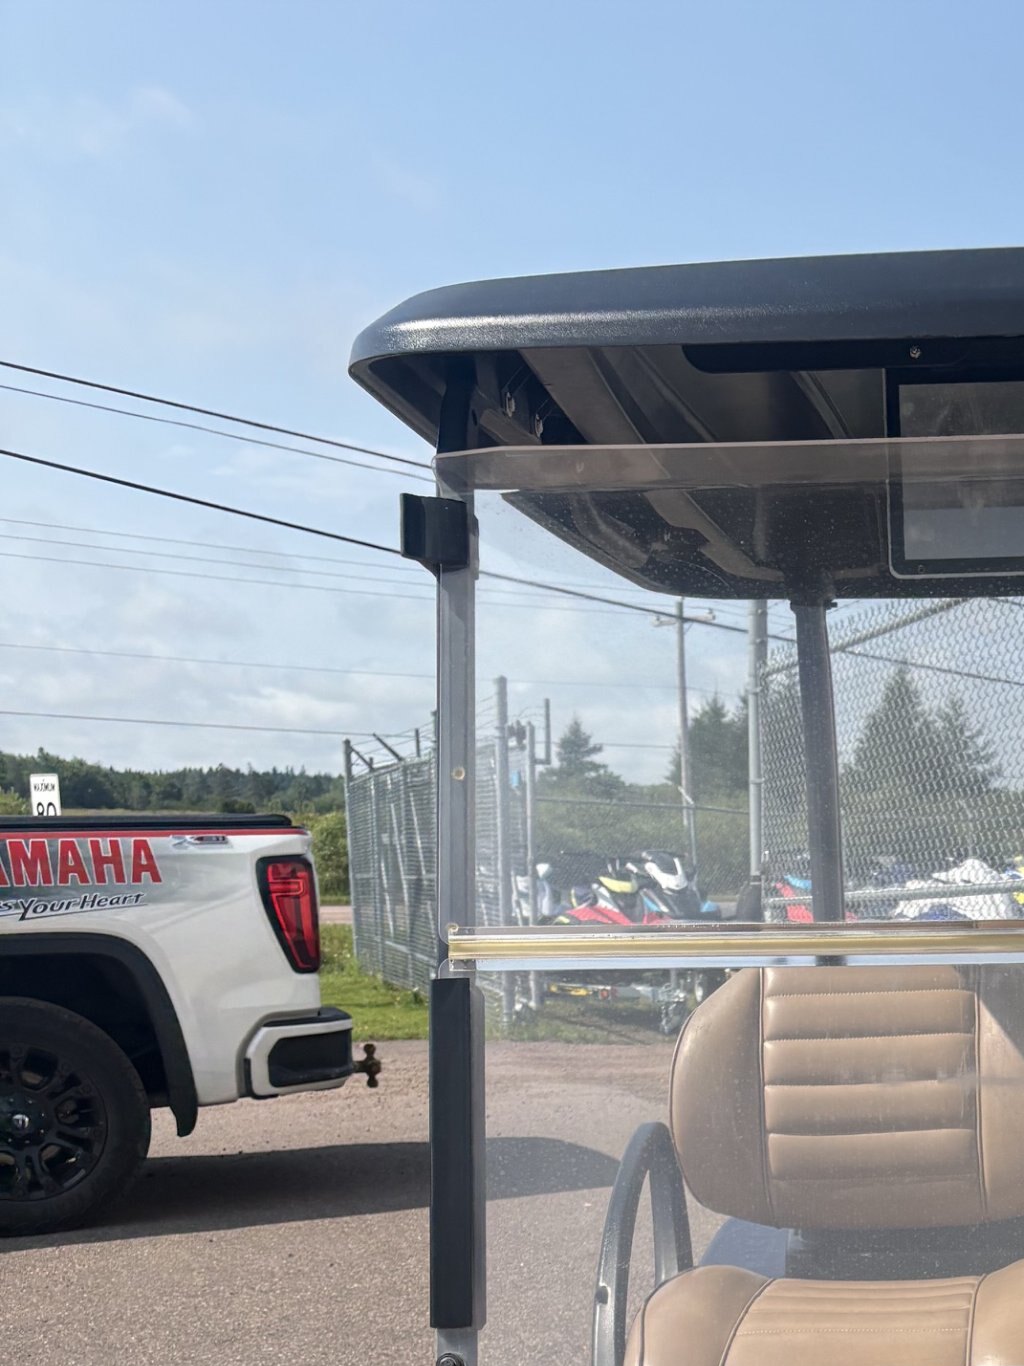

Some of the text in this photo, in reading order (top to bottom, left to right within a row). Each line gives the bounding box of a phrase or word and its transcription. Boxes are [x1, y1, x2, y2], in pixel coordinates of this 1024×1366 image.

[0, 838, 162, 887] MAHA
[19, 898, 79, 921] Your
[80, 892, 146, 910] Heart
